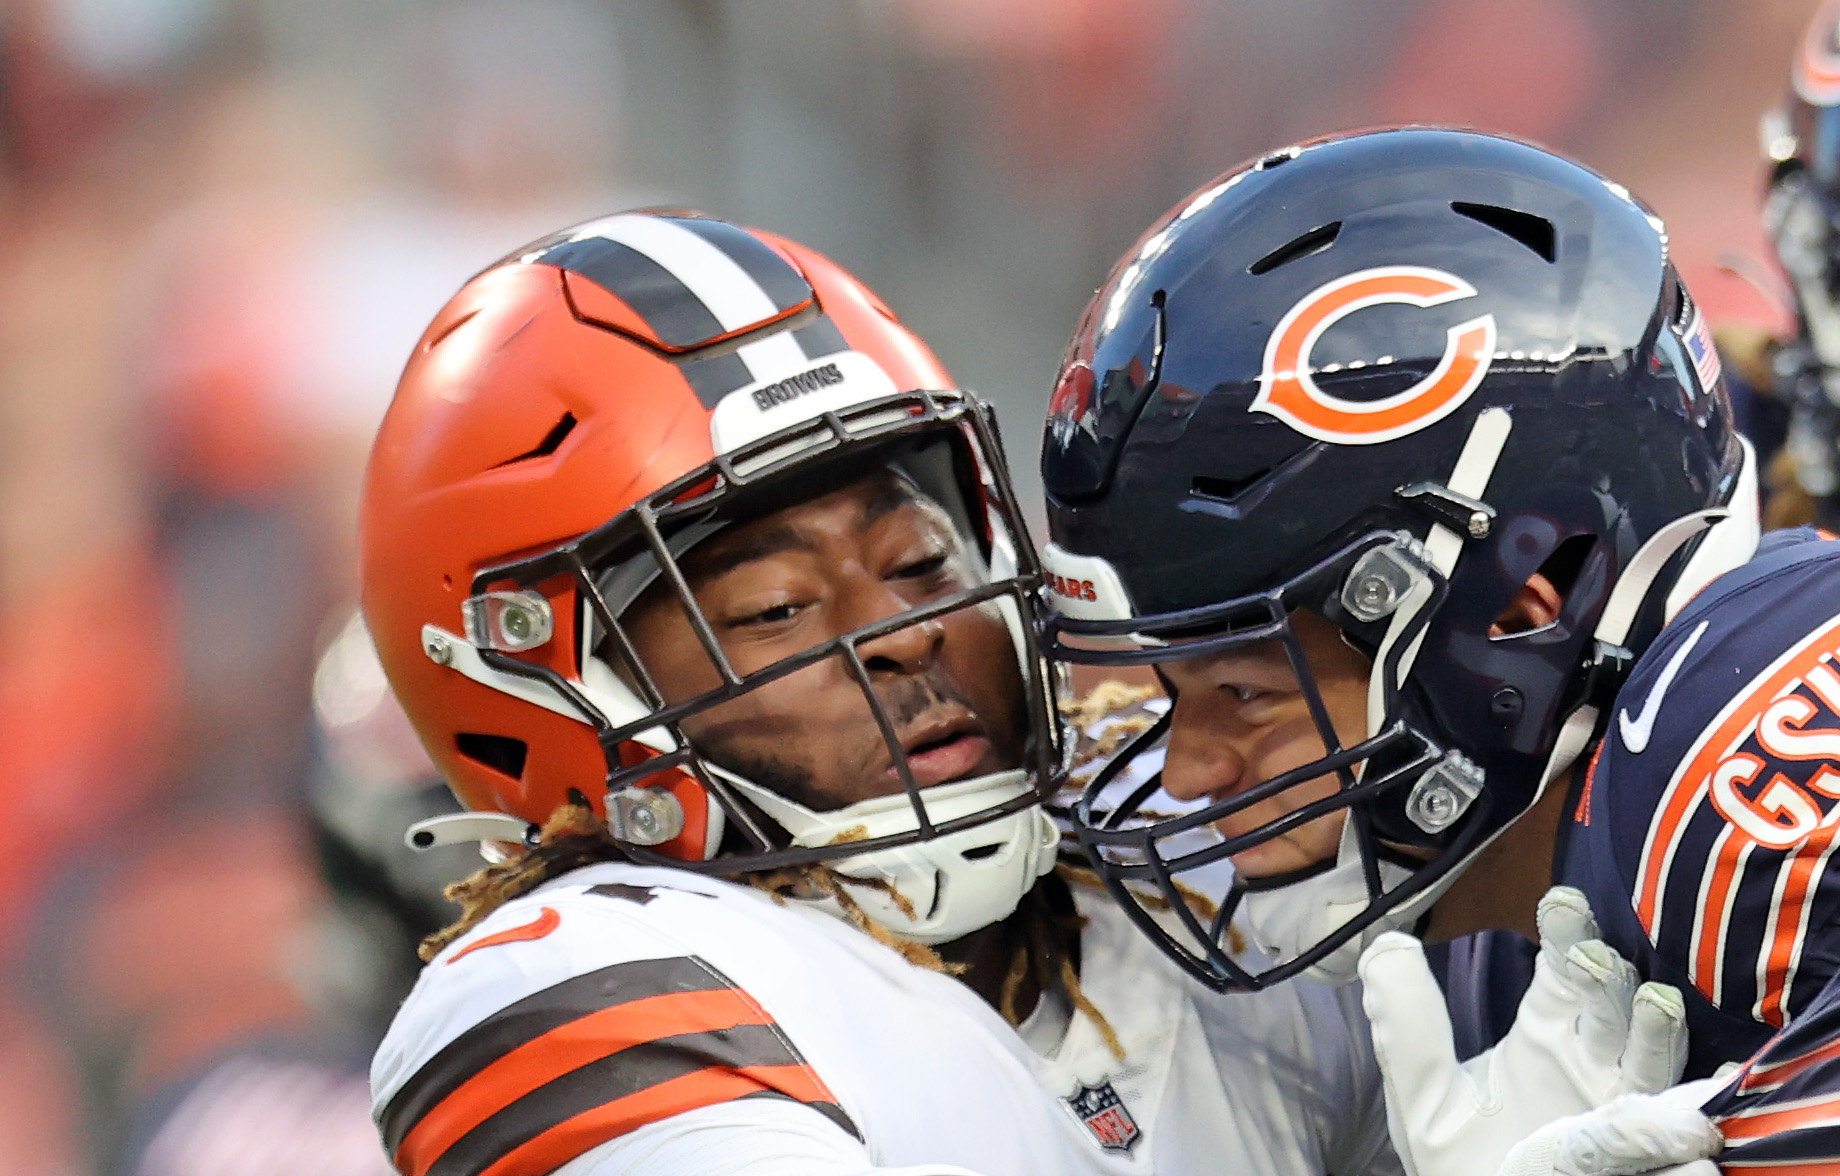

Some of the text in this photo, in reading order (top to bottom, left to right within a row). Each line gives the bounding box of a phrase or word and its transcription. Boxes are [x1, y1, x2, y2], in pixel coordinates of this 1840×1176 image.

[1247, 265, 1497, 445] C
[752, 363, 844, 413] BROWNS
[1087, 1108, 1134, 1144] NFL
